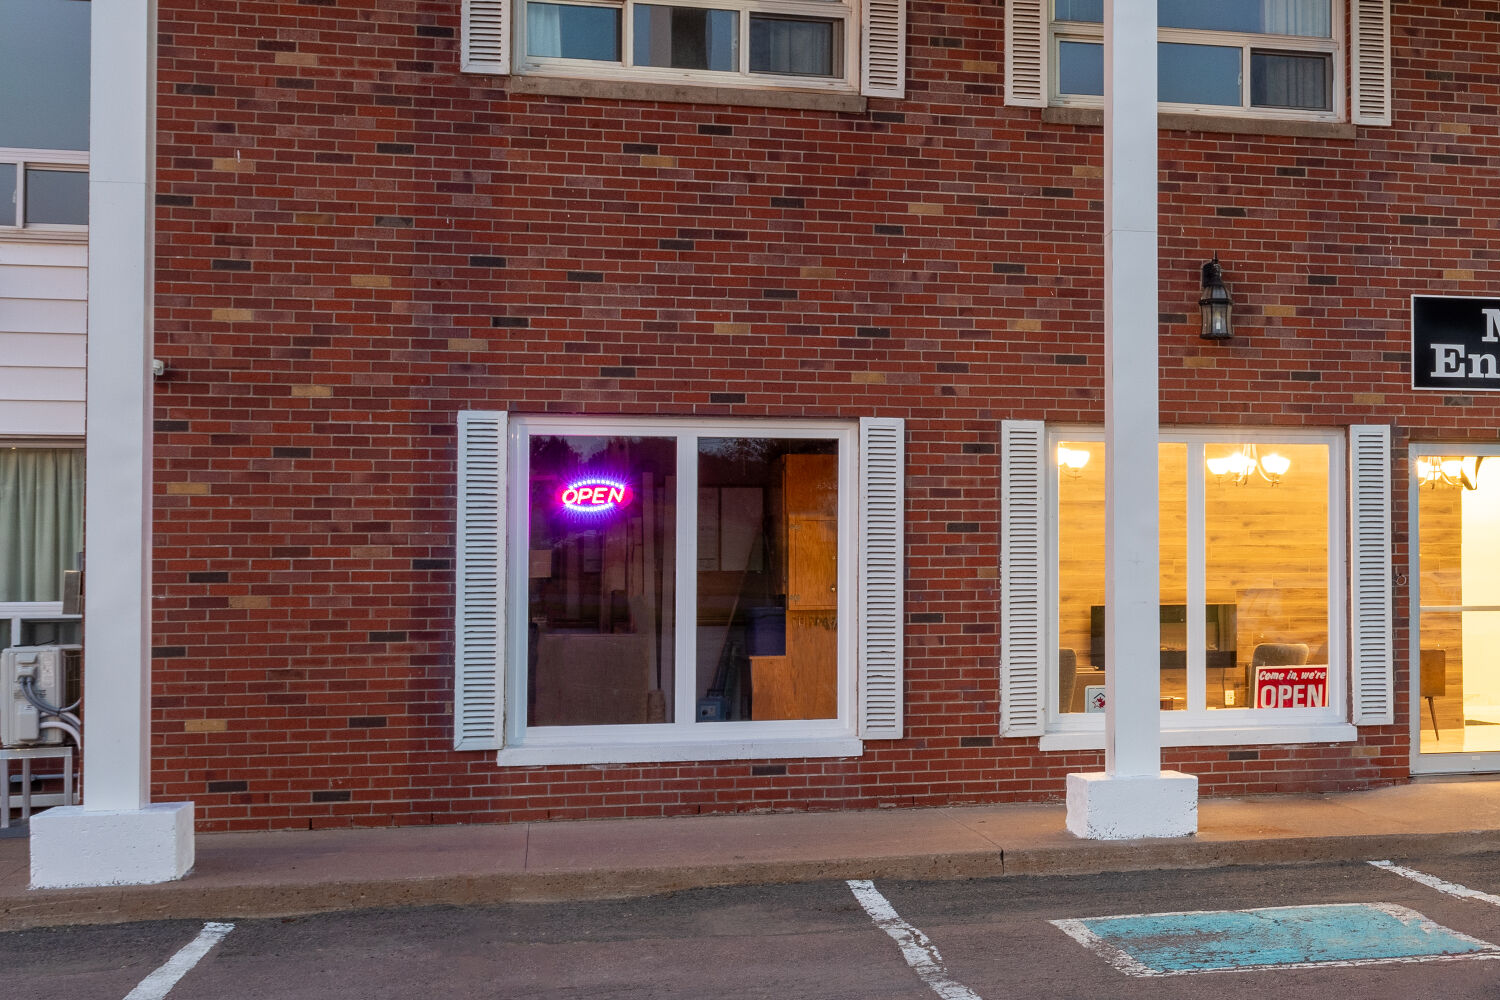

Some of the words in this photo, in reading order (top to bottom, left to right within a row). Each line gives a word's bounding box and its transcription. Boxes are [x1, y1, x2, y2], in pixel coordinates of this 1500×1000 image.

[561, 486, 625, 505] OPEN
[1259, 670, 1285, 681] Come
[1286, 670, 1299, 681] in,
[1300, 670, 1327, 680] we're
[1260, 683, 1324, 709] OPEN
